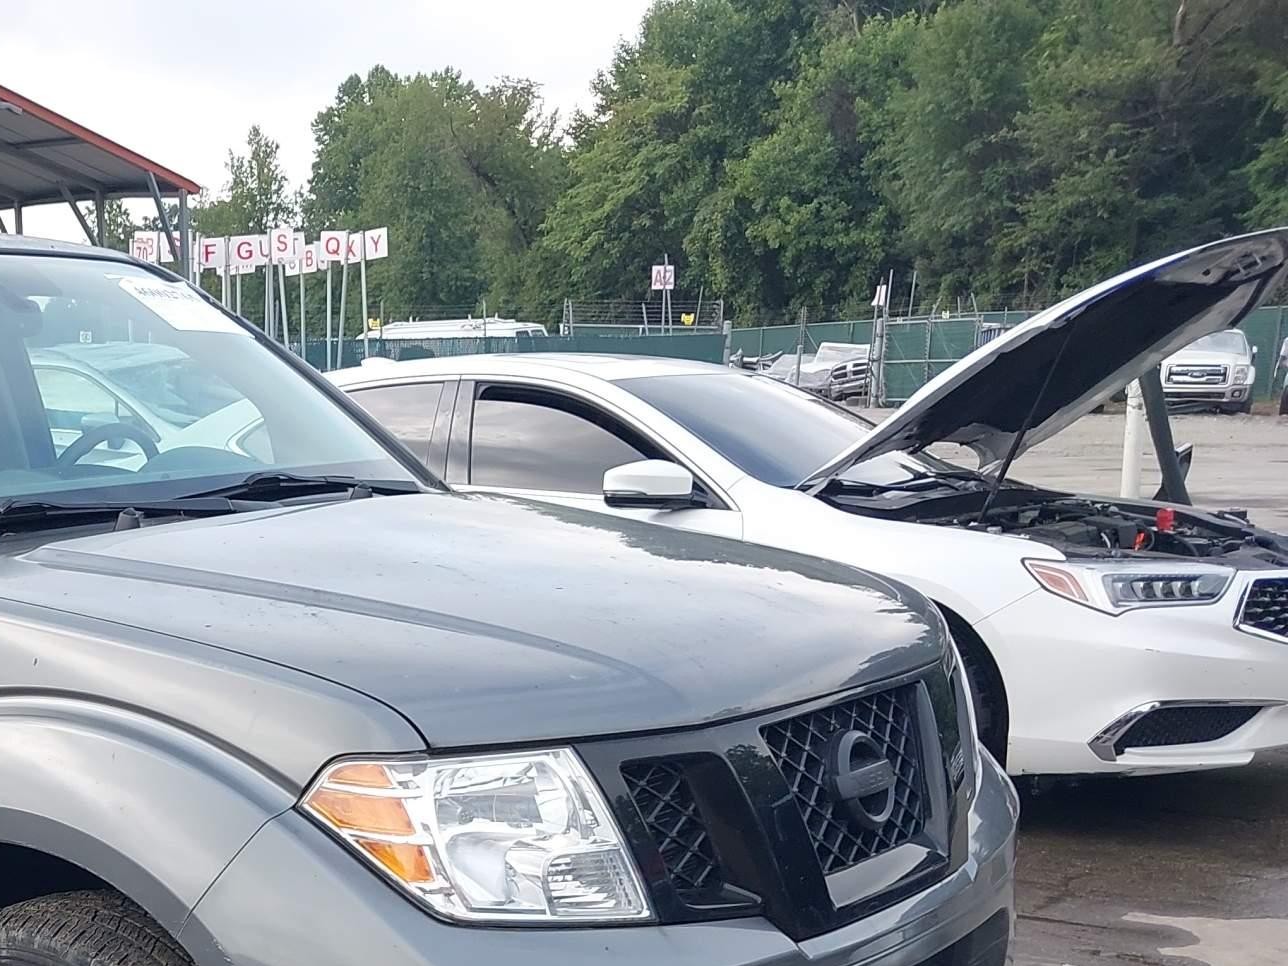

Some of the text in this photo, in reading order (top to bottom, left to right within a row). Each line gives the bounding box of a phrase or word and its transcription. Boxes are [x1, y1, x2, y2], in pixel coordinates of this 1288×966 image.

[236, 241, 253, 260] G
[276, 233, 288, 252] S
[325, 236, 340, 256] Q
[370, 234, 382, 253] Y
[204, 243, 217, 263] F
